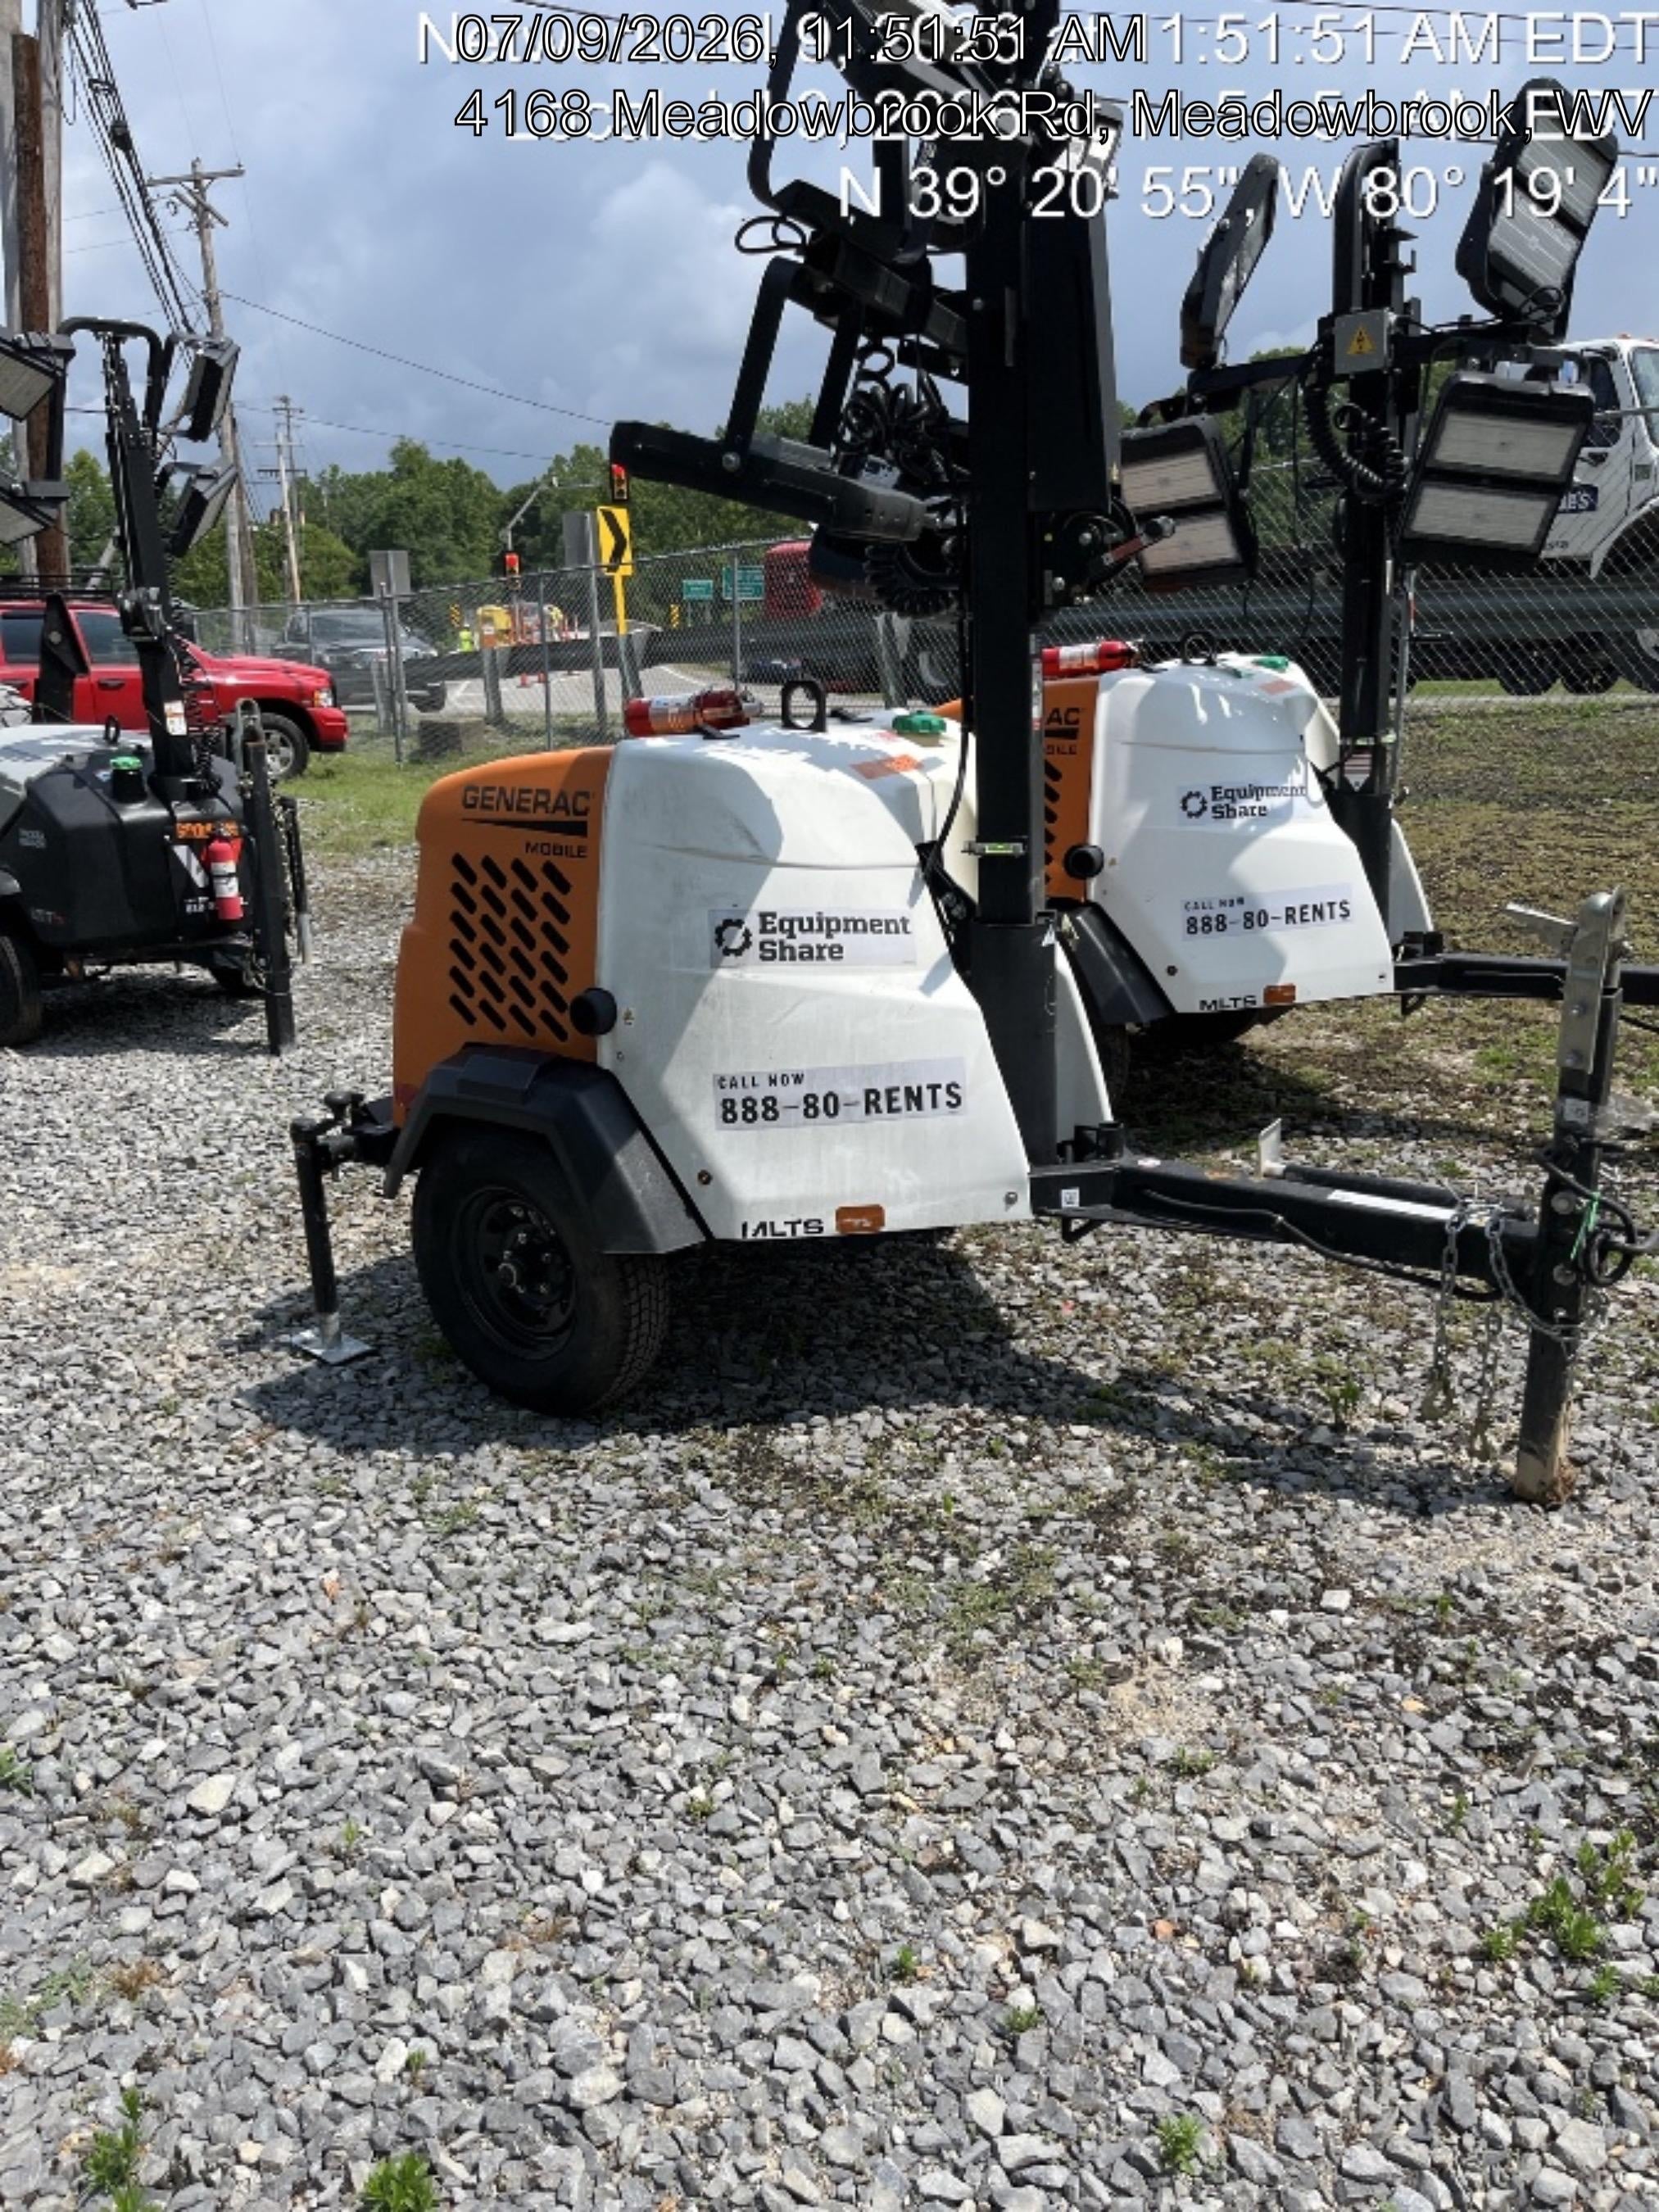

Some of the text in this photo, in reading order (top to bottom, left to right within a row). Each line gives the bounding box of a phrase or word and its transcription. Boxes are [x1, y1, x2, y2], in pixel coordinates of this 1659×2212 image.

[462, 785, 591, 817] GENERAC
[525, 841, 588, 859] MOBILE
[758, 911, 912, 940] Equipment
[1186, 900, 1351, 936] 888-80-RENTS
[758, 939, 845, 963] Share
[1199, 995, 1257, 1011] MLTS
[717, 1072, 805, 1090] CALL NOW
[721, 1081, 963, 1125] 888-80-RENTS
